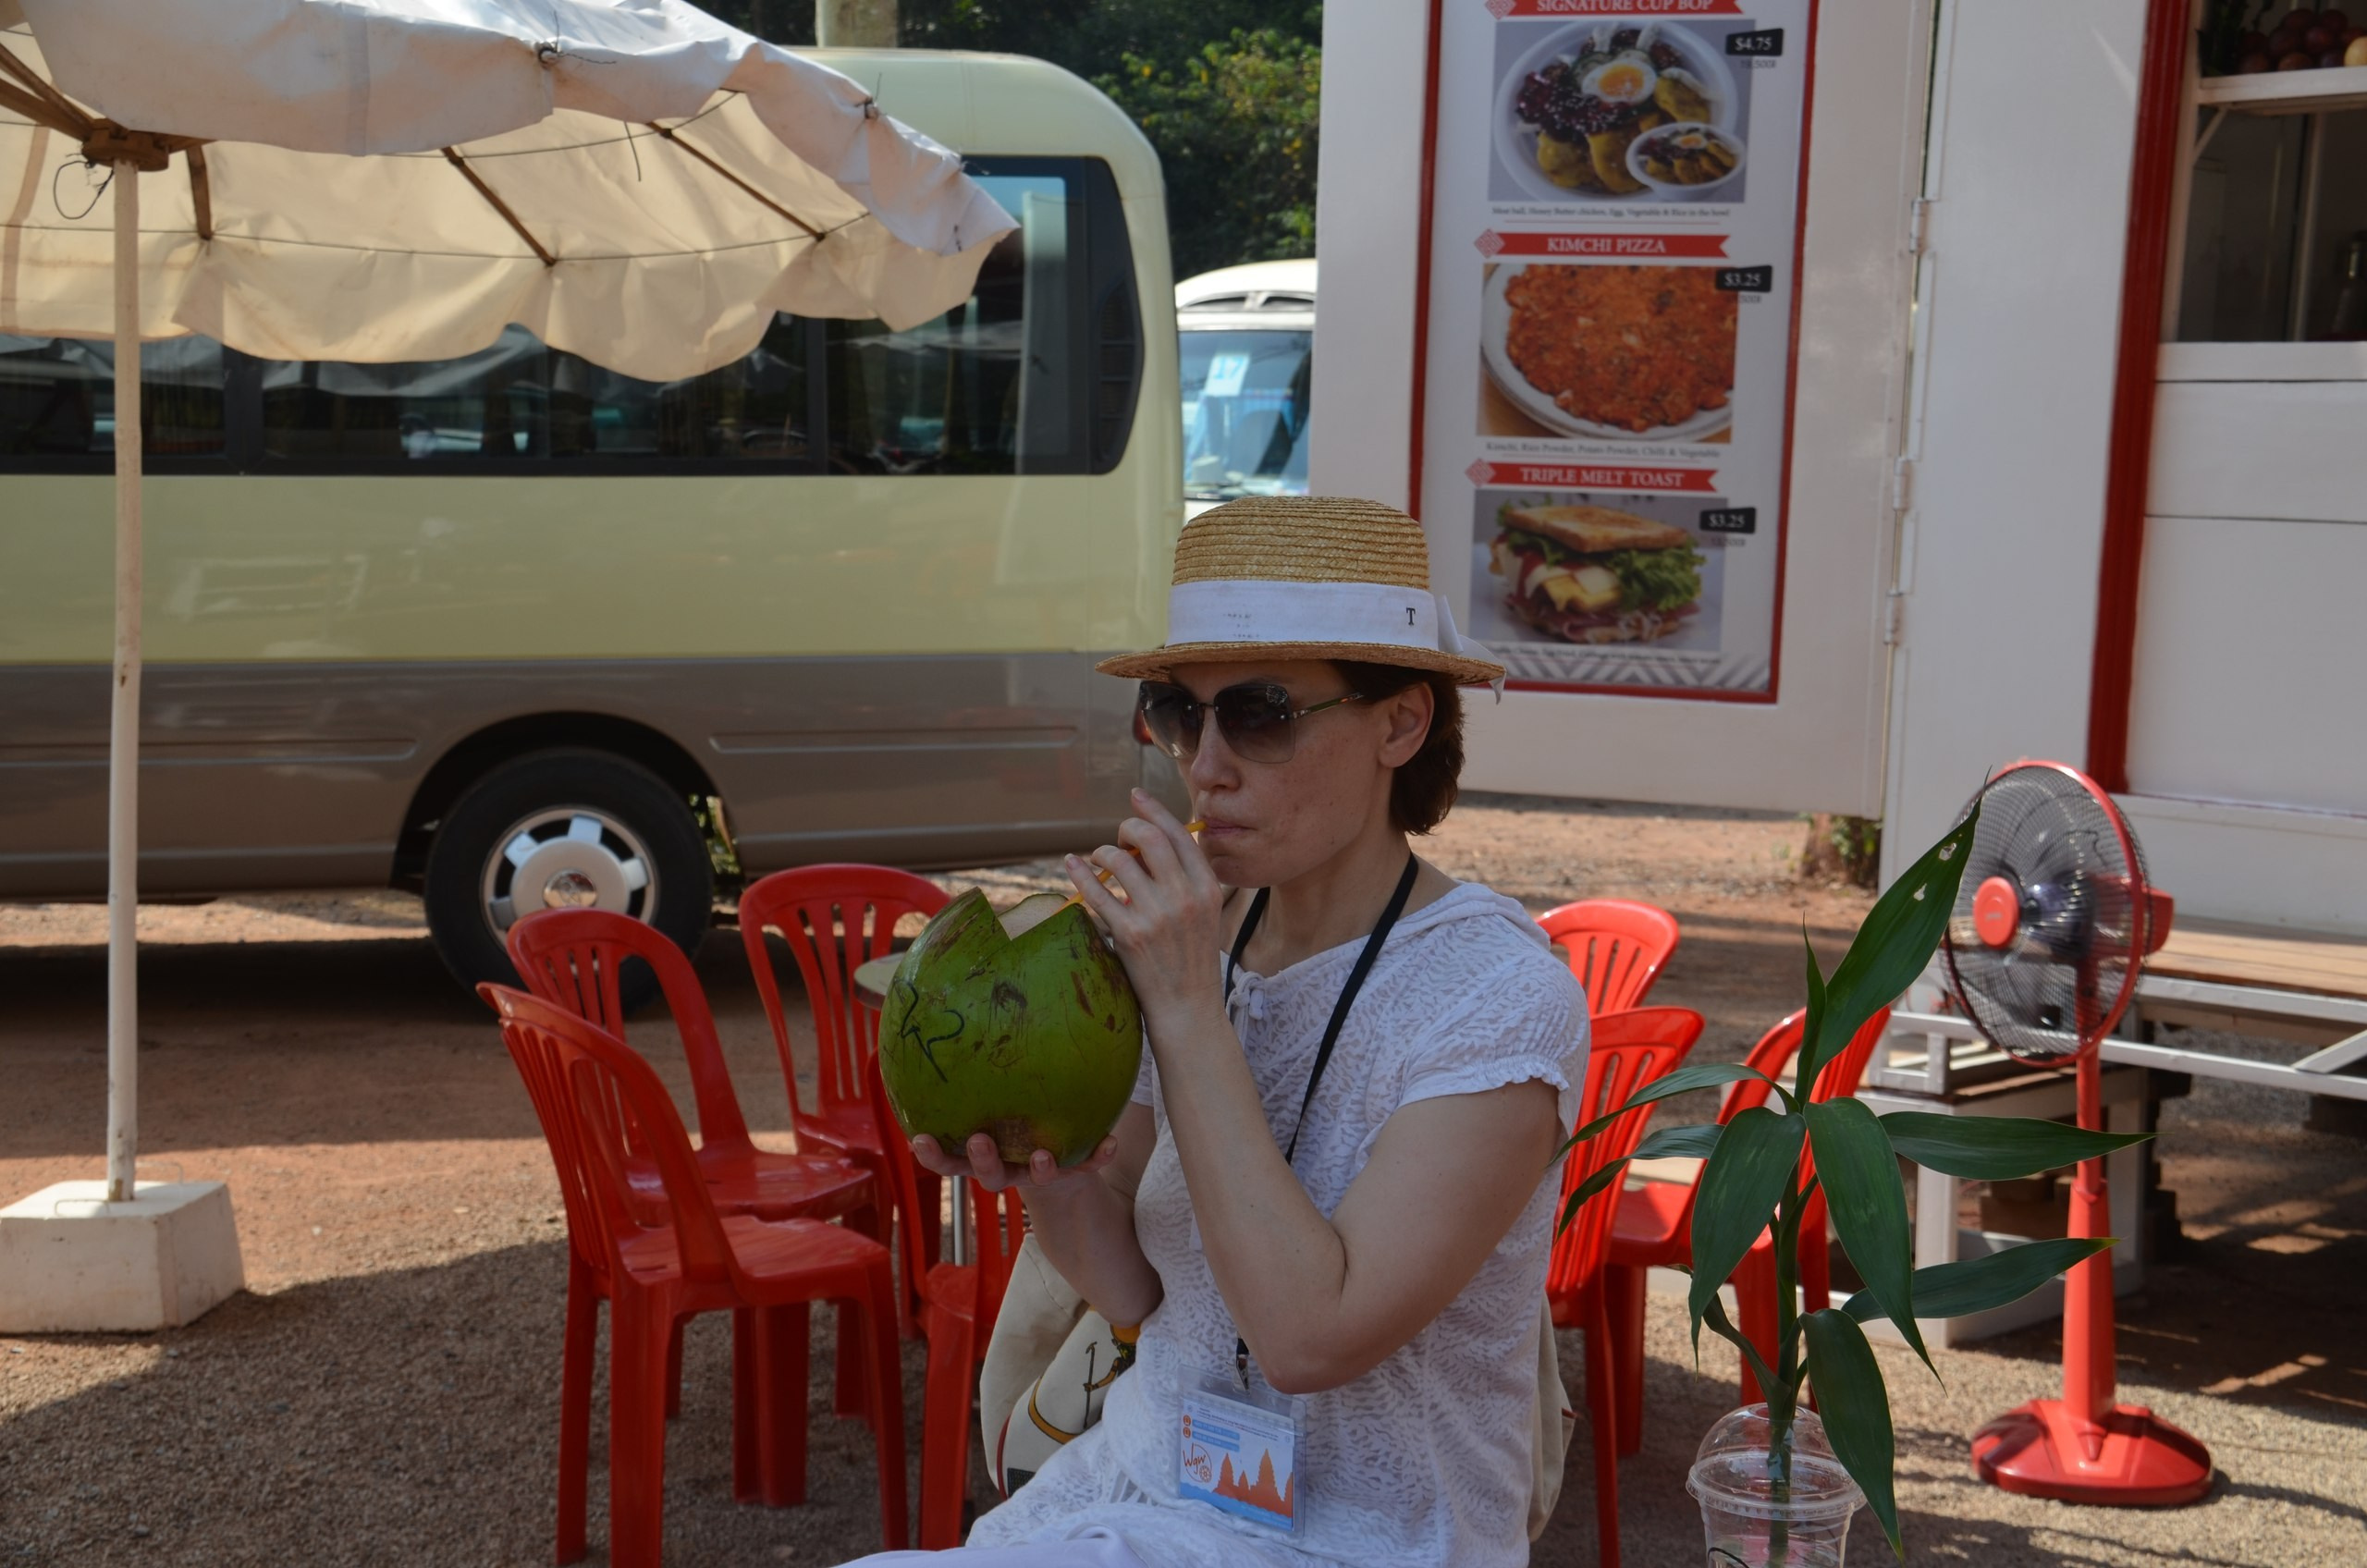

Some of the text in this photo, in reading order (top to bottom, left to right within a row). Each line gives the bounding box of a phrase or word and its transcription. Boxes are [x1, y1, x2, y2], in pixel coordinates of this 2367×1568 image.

[1537, 0, 1712, 12] SIGNATURE CUP BOP
[1735, 36, 1772, 51] $4.75
[1547, 238, 1666, 253] KIMCHI PIZZA
[1724, 272, 1761, 287] $3.25
[1519, 466, 1685, 487] TRIPLE MELT TOAST
[1709, 513, 1746, 528] $3.25
[1405, 606, 1417, 626] T
